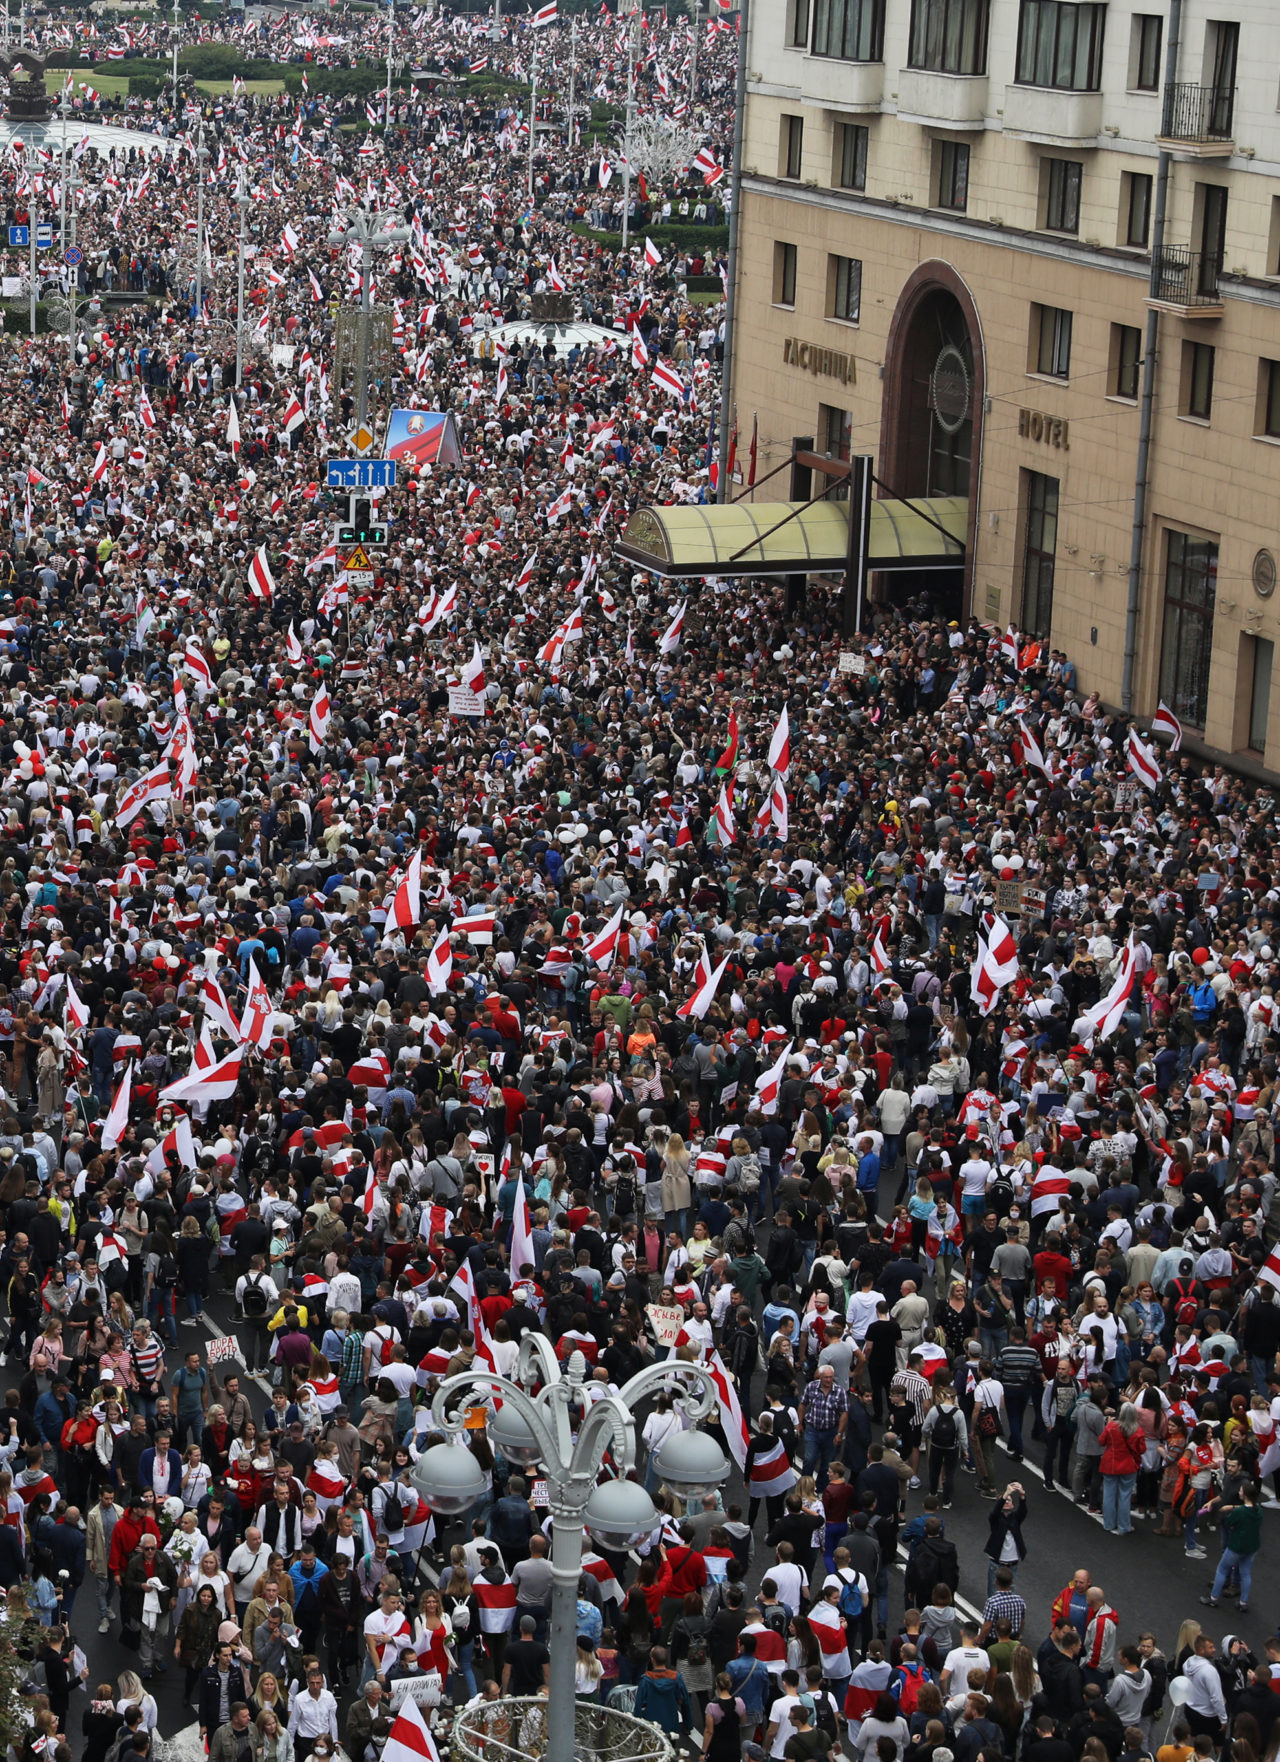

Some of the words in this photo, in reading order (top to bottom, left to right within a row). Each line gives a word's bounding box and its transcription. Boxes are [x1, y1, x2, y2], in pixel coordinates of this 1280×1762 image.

[784, 338, 856, 386] ГАСЦІНІЦА
[1018, 409, 1070, 451] HOTEL
[210, 1336, 234, 1349] ПОРА
